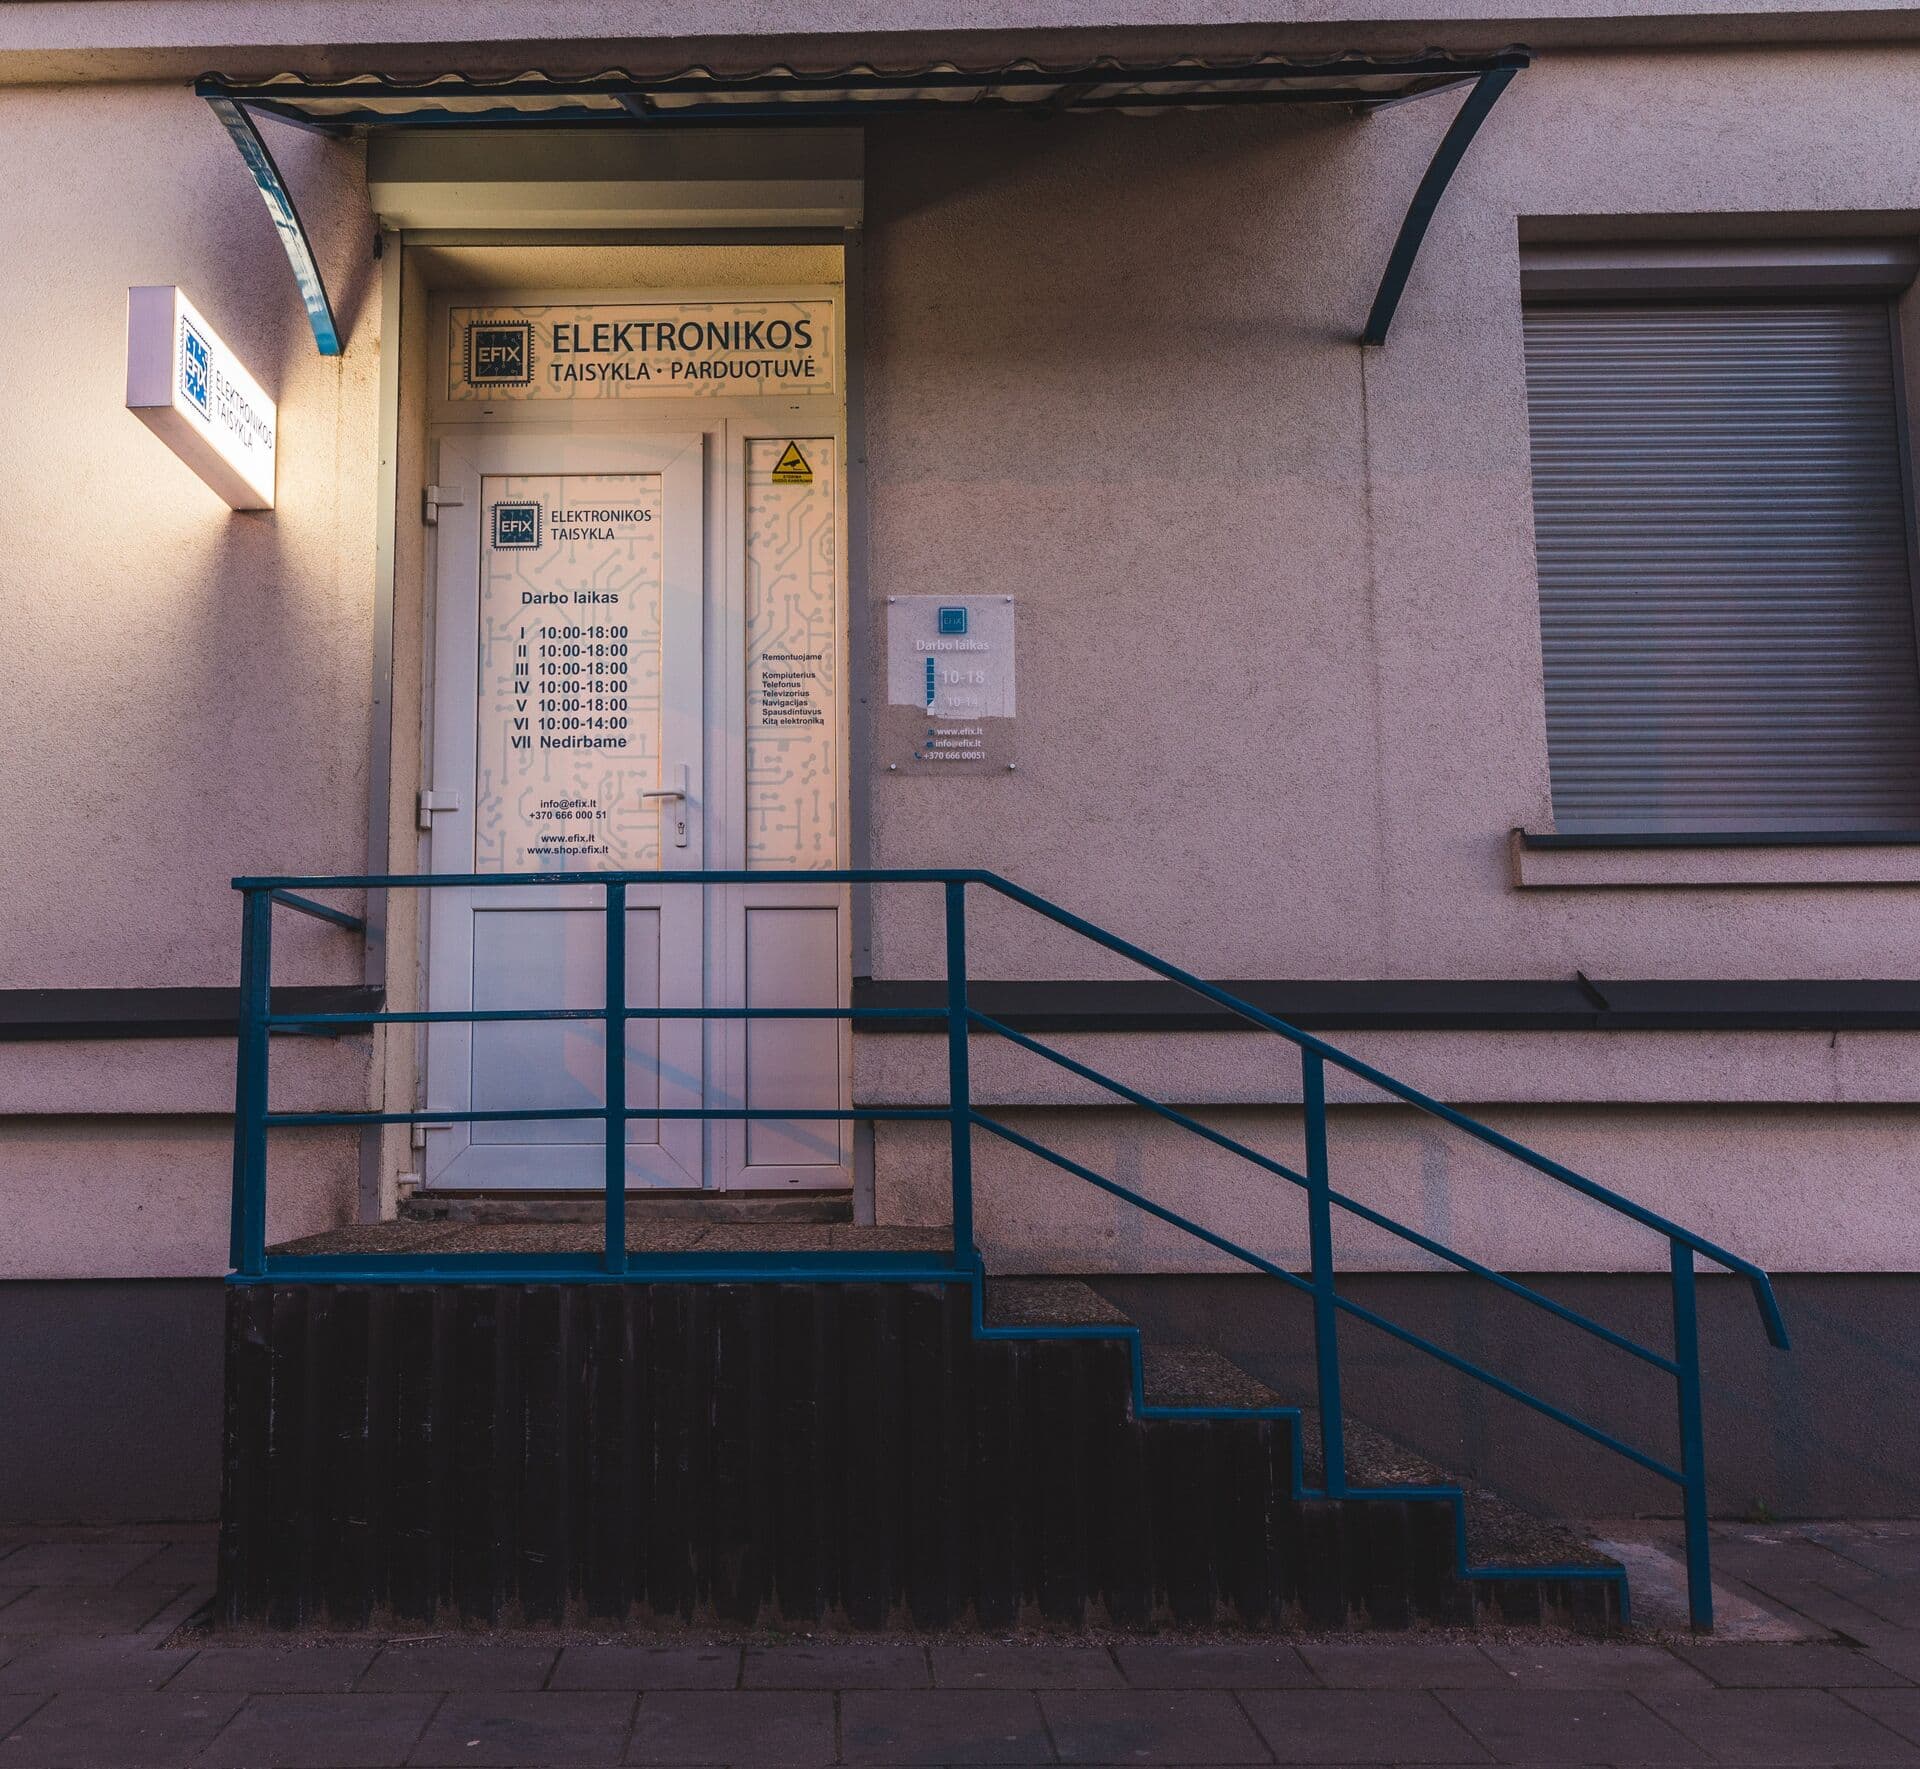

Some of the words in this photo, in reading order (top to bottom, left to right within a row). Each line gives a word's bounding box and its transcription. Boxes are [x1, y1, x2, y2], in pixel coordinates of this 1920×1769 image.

[552, 319, 813, 353] ELEKTRONIKOS
[478, 345, 520, 363] EFIX
[186, 356, 208, 386] EFIX
[551, 362, 651, 382] TAISYKLA
[671, 354, 815, 380] PARDUOTUVĖ
[215, 369, 273, 450] ELEKTRONIKOS
[215, 394, 254, 448] TAISYKLA
[551, 509, 652, 523] ELEKTRONIKOS
[501, 519, 533, 533] EFIX
[551, 527, 615, 540] TAISYKLA
[521, 591, 569, 604] Darbo
[574, 591, 619, 604] laikas
[520, 626, 525, 639] I
[539, 626, 628, 639] 10:00-18:00
[518, 644, 527, 657] II
[539, 644, 628, 657] 10:00-18:00
[916, 639, 955, 651] Darbo
[956, 639, 990, 651] laikas
[762, 653, 823, 662] Remontuojame
[515, 662, 529, 675] III
[539, 662, 628, 675] 10:00-18:00
[762, 671, 816, 680] Kompiuterius
[942, 670, 985, 685] 10-18
[514, 680, 530, 694] IV
[539, 680, 628, 694] 10:00-18:00
[762, 680, 801, 688] Telefonus
[762, 689, 810, 697] Televizorius
[516, 699, 527, 712] V
[539, 699, 628, 712] 10:00-18:00
[762, 699, 809, 708] Navigacijas
[762, 708, 822, 717] Spausdintuvus
[513, 717, 529, 730] VI
[539, 717, 628, 730] 10:00-14:00
[762, 717, 778, 726] Kitą
[780, 717, 825, 726] elektroniką
[936, 728, 984, 736] www.efix.lt
[511, 735, 531, 748] VII
[539, 735, 628, 748] Nedirbame
[935, 740, 982, 748] info@efix.lt
[923, 752, 944, 760] +370
[945, 752, 961, 760] 666
[961, 752, 986, 760] 00051
[540, 799, 597, 810] info@efix.lt
[529, 810, 553, 820] +370
[555, 810, 573, 820] 666
[575, 810, 593, 820] 000
[596, 810, 607, 820] 51
[541, 834, 595, 843] www.efix.lt
[527, 845, 609, 856] www.shop.efix.lt
